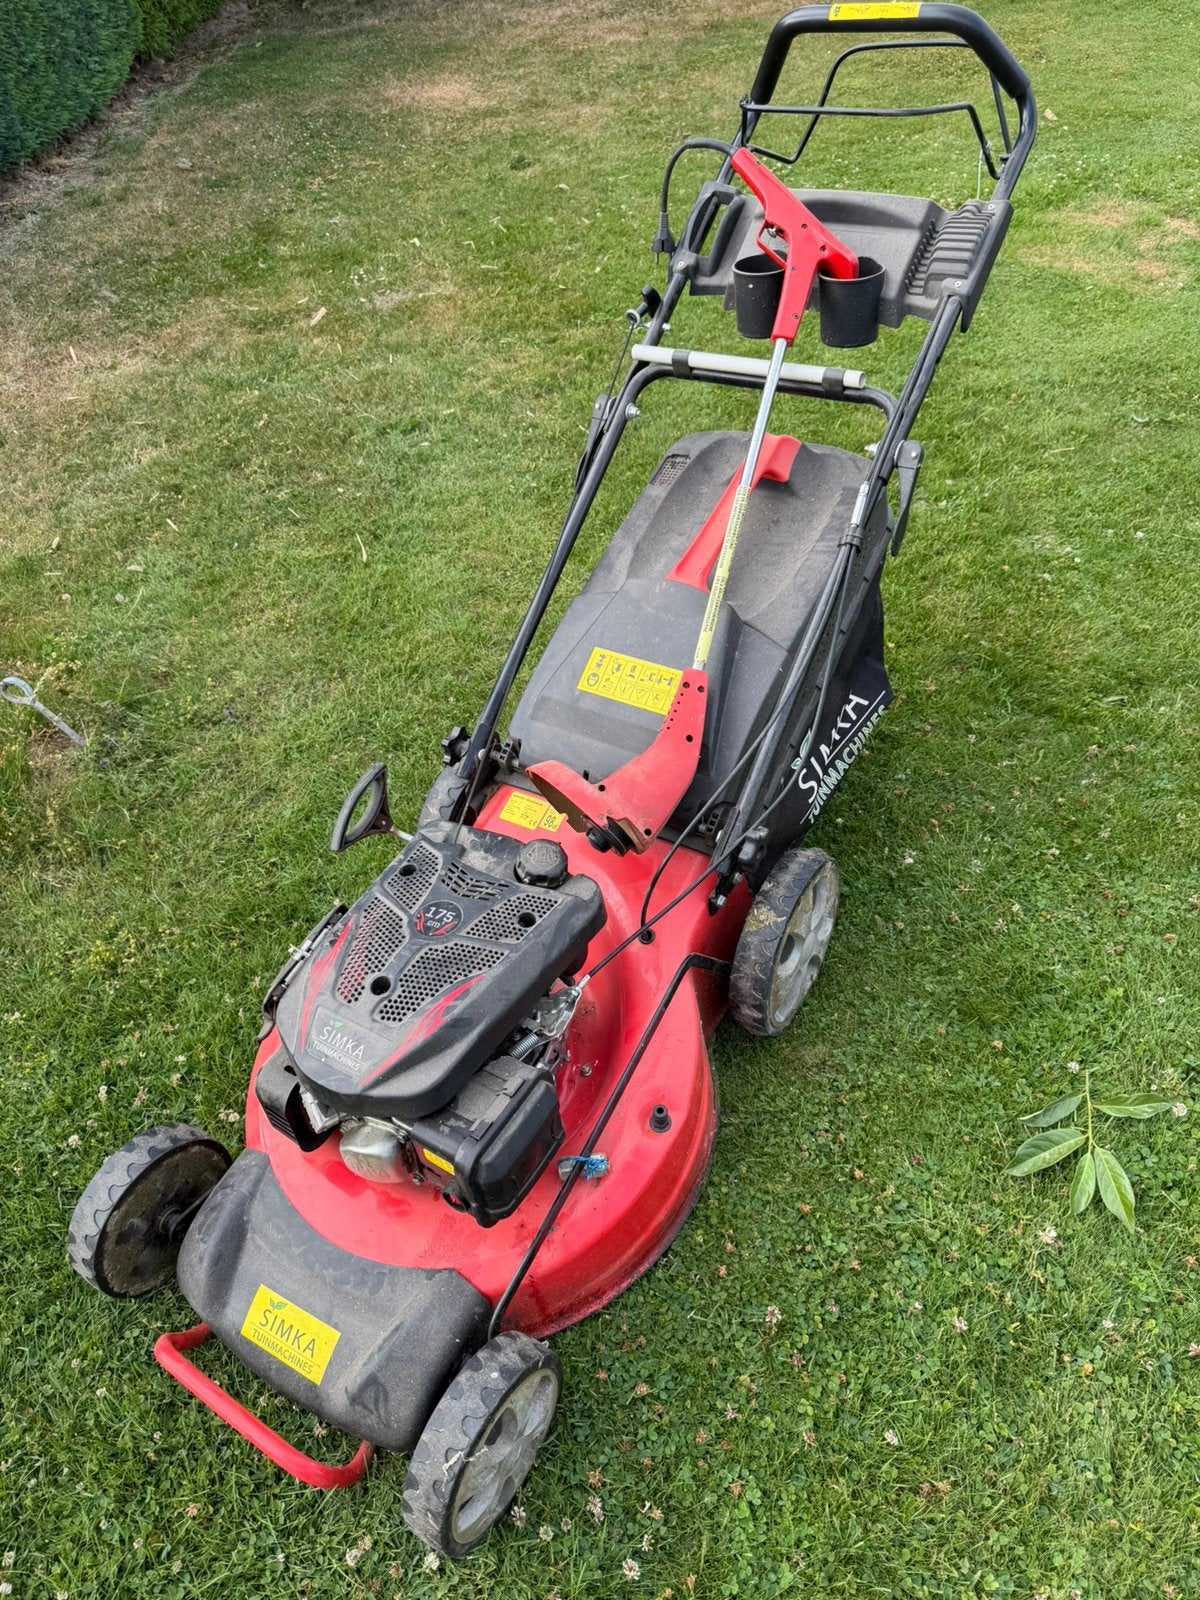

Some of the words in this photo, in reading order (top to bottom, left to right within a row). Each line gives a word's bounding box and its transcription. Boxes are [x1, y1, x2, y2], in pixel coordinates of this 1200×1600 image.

[425, 906, 456, 922] 175
[312, 1040, 361, 1071] TUINMACHINES
[319, 1026, 365, 1060] SIMKA
[258, 1308, 317, 1359] SIMKA
[251, 1327, 314, 1375] TUINMACHINES
